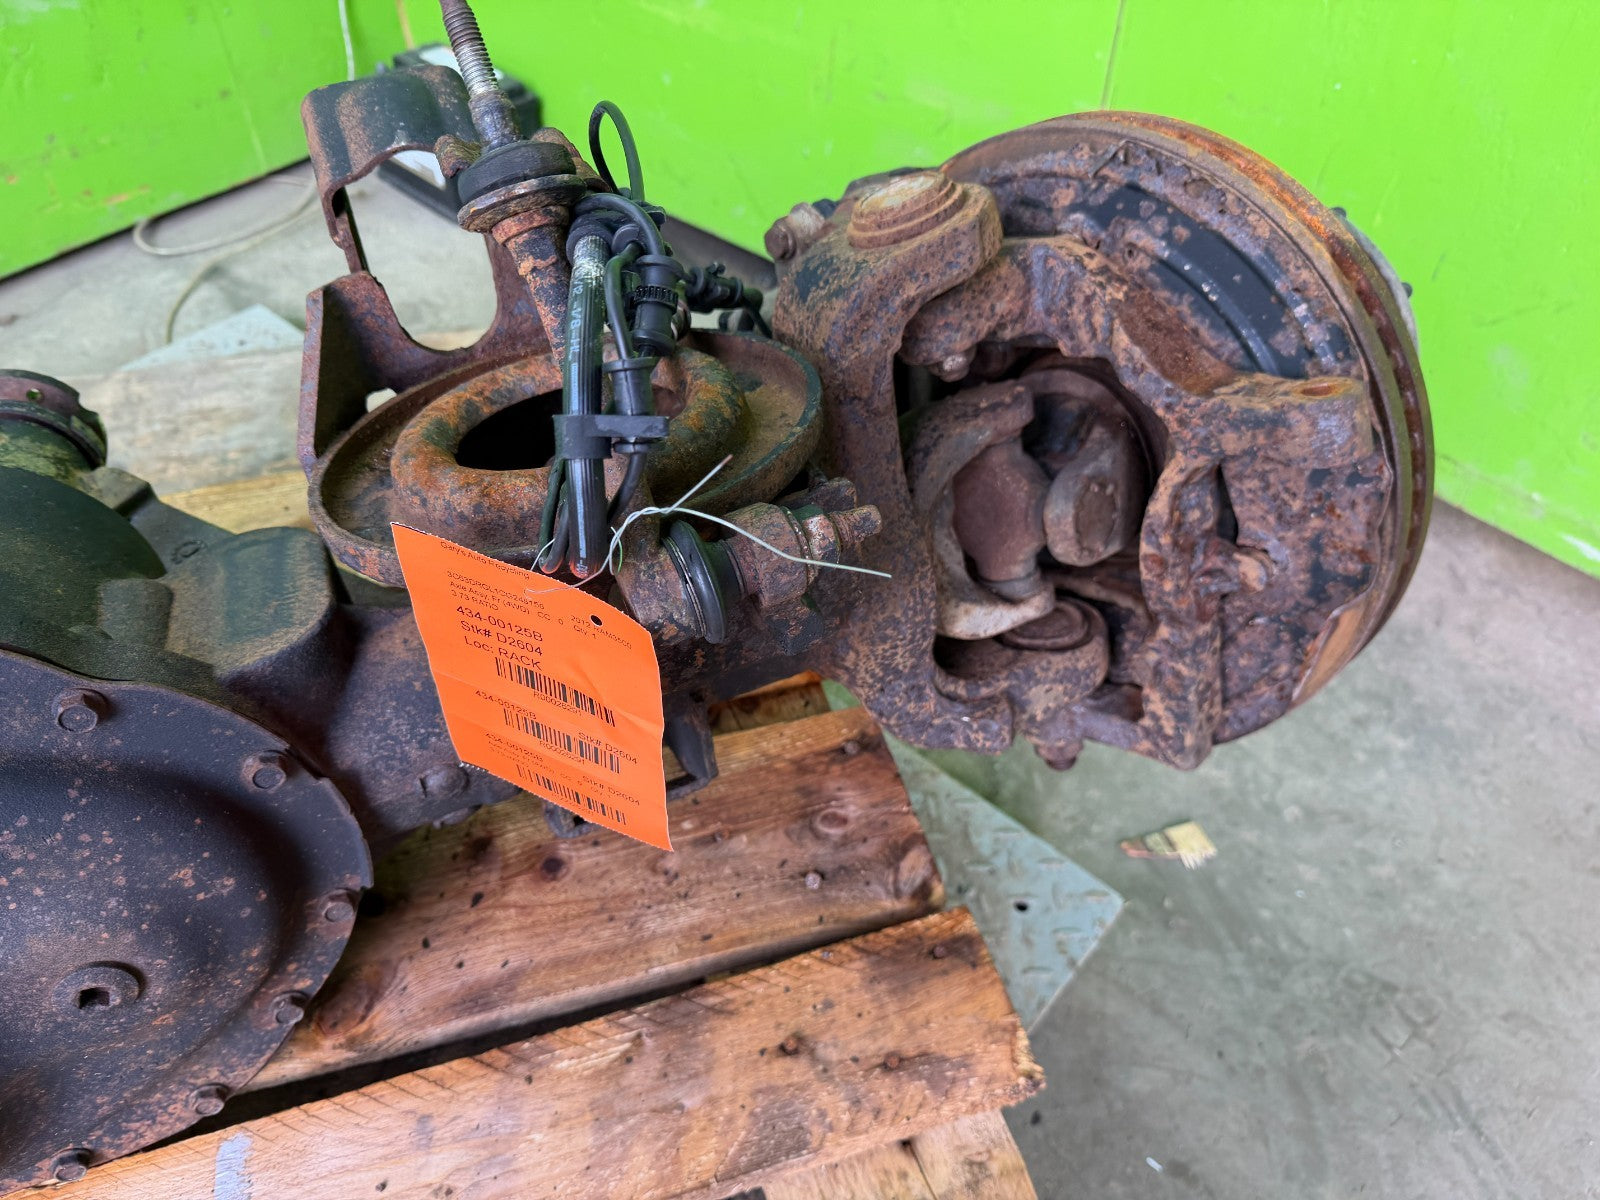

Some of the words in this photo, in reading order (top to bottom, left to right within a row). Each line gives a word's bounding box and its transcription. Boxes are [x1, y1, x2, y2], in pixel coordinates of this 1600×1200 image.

[467, 552, 487, 565] Auto
[488, 559, 530, 580] Recycling
[450, 581, 467, 592] Axle
[537, 611, 551, 621] CC
[471, 596, 499, 611] RATIO
[456, 606, 543, 642] 434-00125B
[460, 620, 492, 638] Stk#
[496, 632, 543, 657] D2604
[570, 614, 591, 629] 2012
[464, 635, 494, 654] Loc:
[498, 647, 543, 671] RACK
[475, 690, 537, 720] 434-00125B
[578, 732, 602, 747] Stk#
[605, 743, 638, 765] D2604
